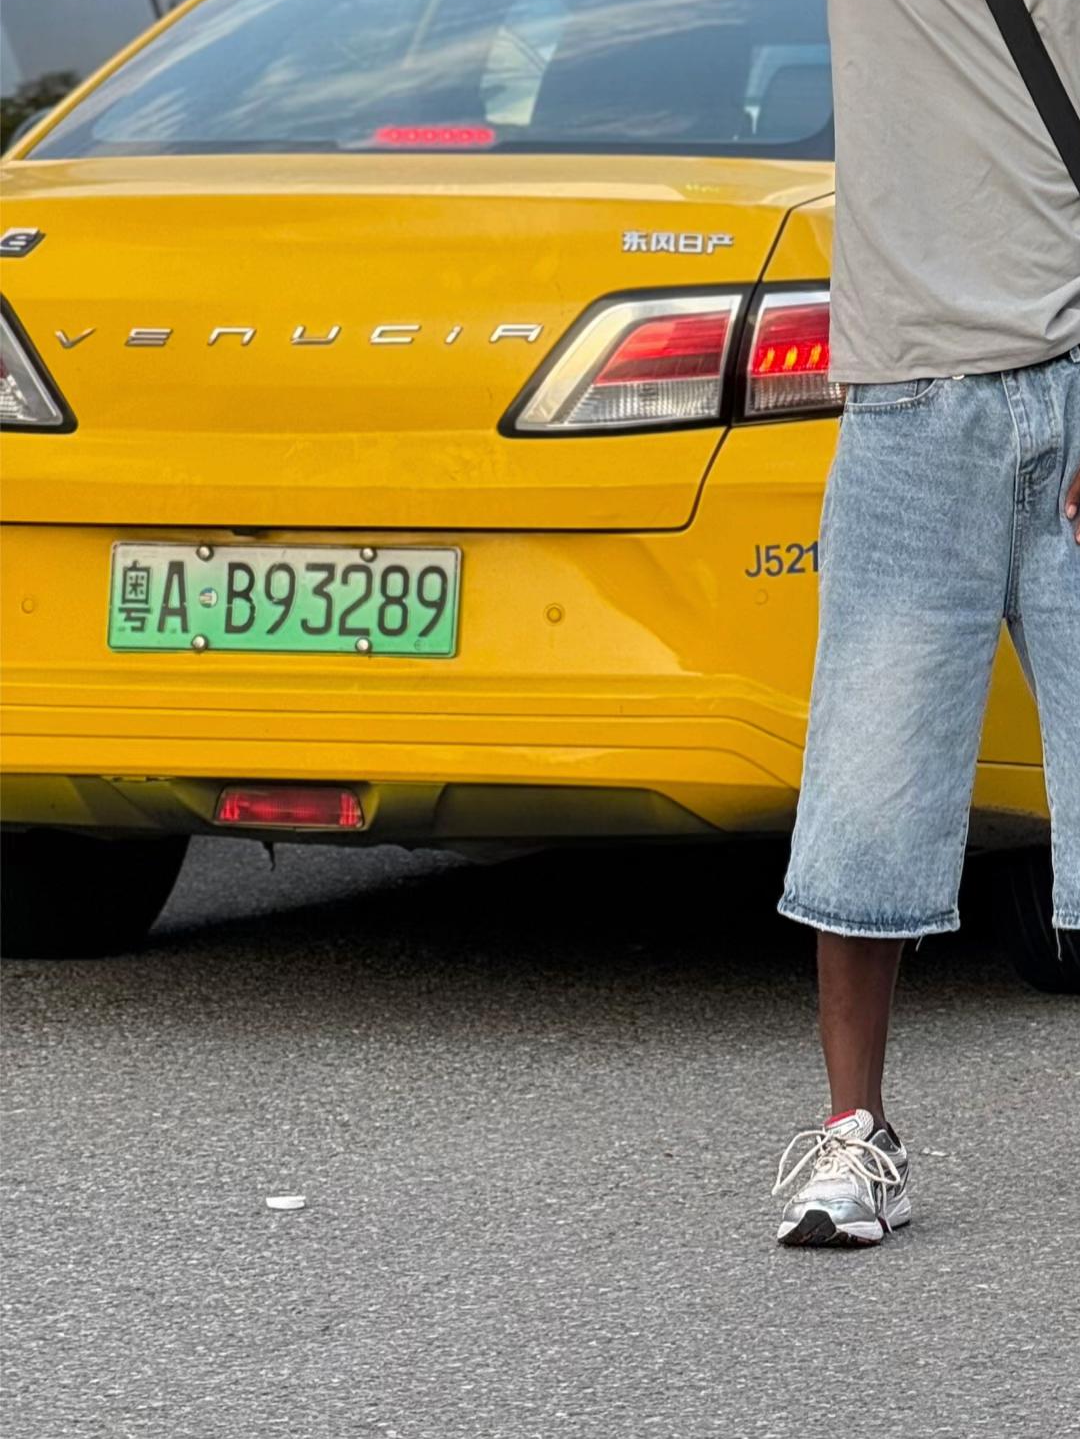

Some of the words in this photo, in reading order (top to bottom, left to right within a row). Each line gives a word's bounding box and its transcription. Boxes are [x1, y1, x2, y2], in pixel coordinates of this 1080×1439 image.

[623, 231, 734, 254] 东风日产
[54, 324, 543, 349] VENUCIA
